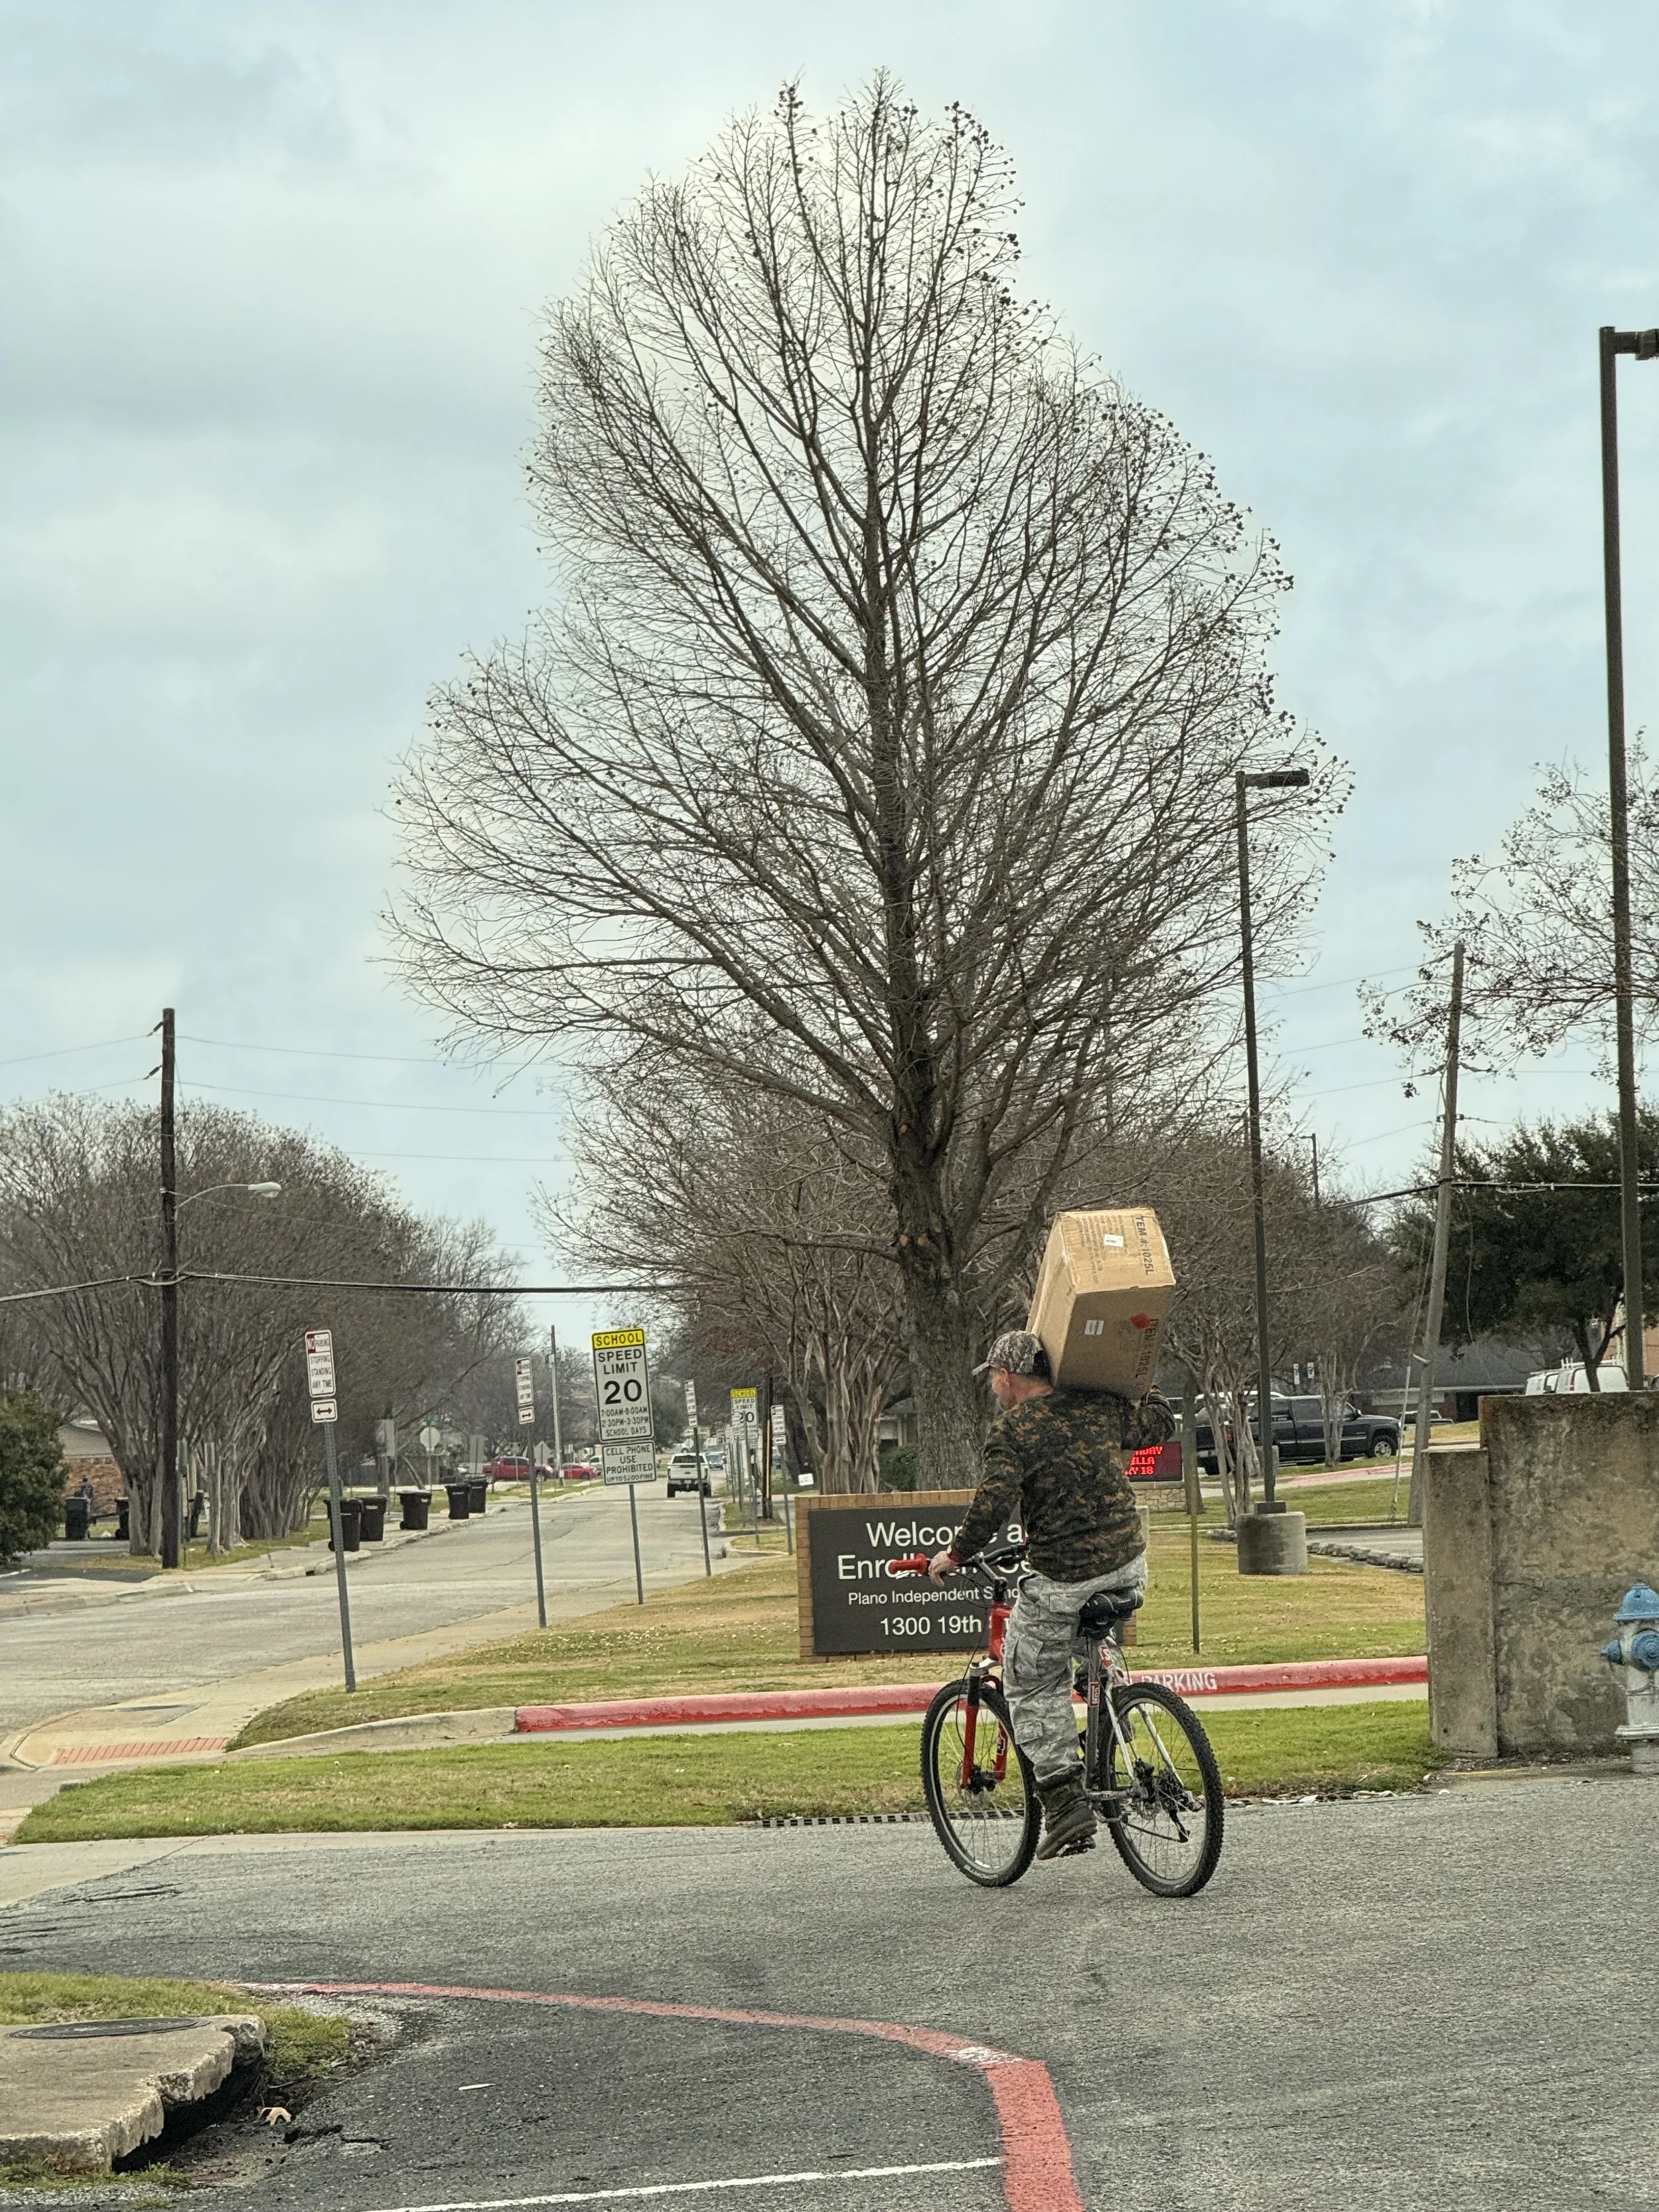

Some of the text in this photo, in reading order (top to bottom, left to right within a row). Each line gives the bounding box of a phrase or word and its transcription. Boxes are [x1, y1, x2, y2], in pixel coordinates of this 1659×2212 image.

[596, 1332, 642, 1347] SCHOOL
[598, 1349, 642, 1363] SPEED
[603, 1362, 638, 1375] LIMIT
[604, 1379, 642, 1405] 20
[606, 1426, 647, 1437] SCHOOL DAYS
[606, 1444, 651, 1456] CELL PHONE
[620, 1455, 636, 1464] USE
[606, 1463, 654, 1474] PROHIBITED
[1141, 1465, 1153, 1475] 18
[866, 1521, 997, 1547] Welco
[849, 1592, 887, 1605] Plano
[892, 1587, 979, 1605] Independent
[880, 1617, 930, 1635] 1300
[938, 1615, 981, 1634] 19th
